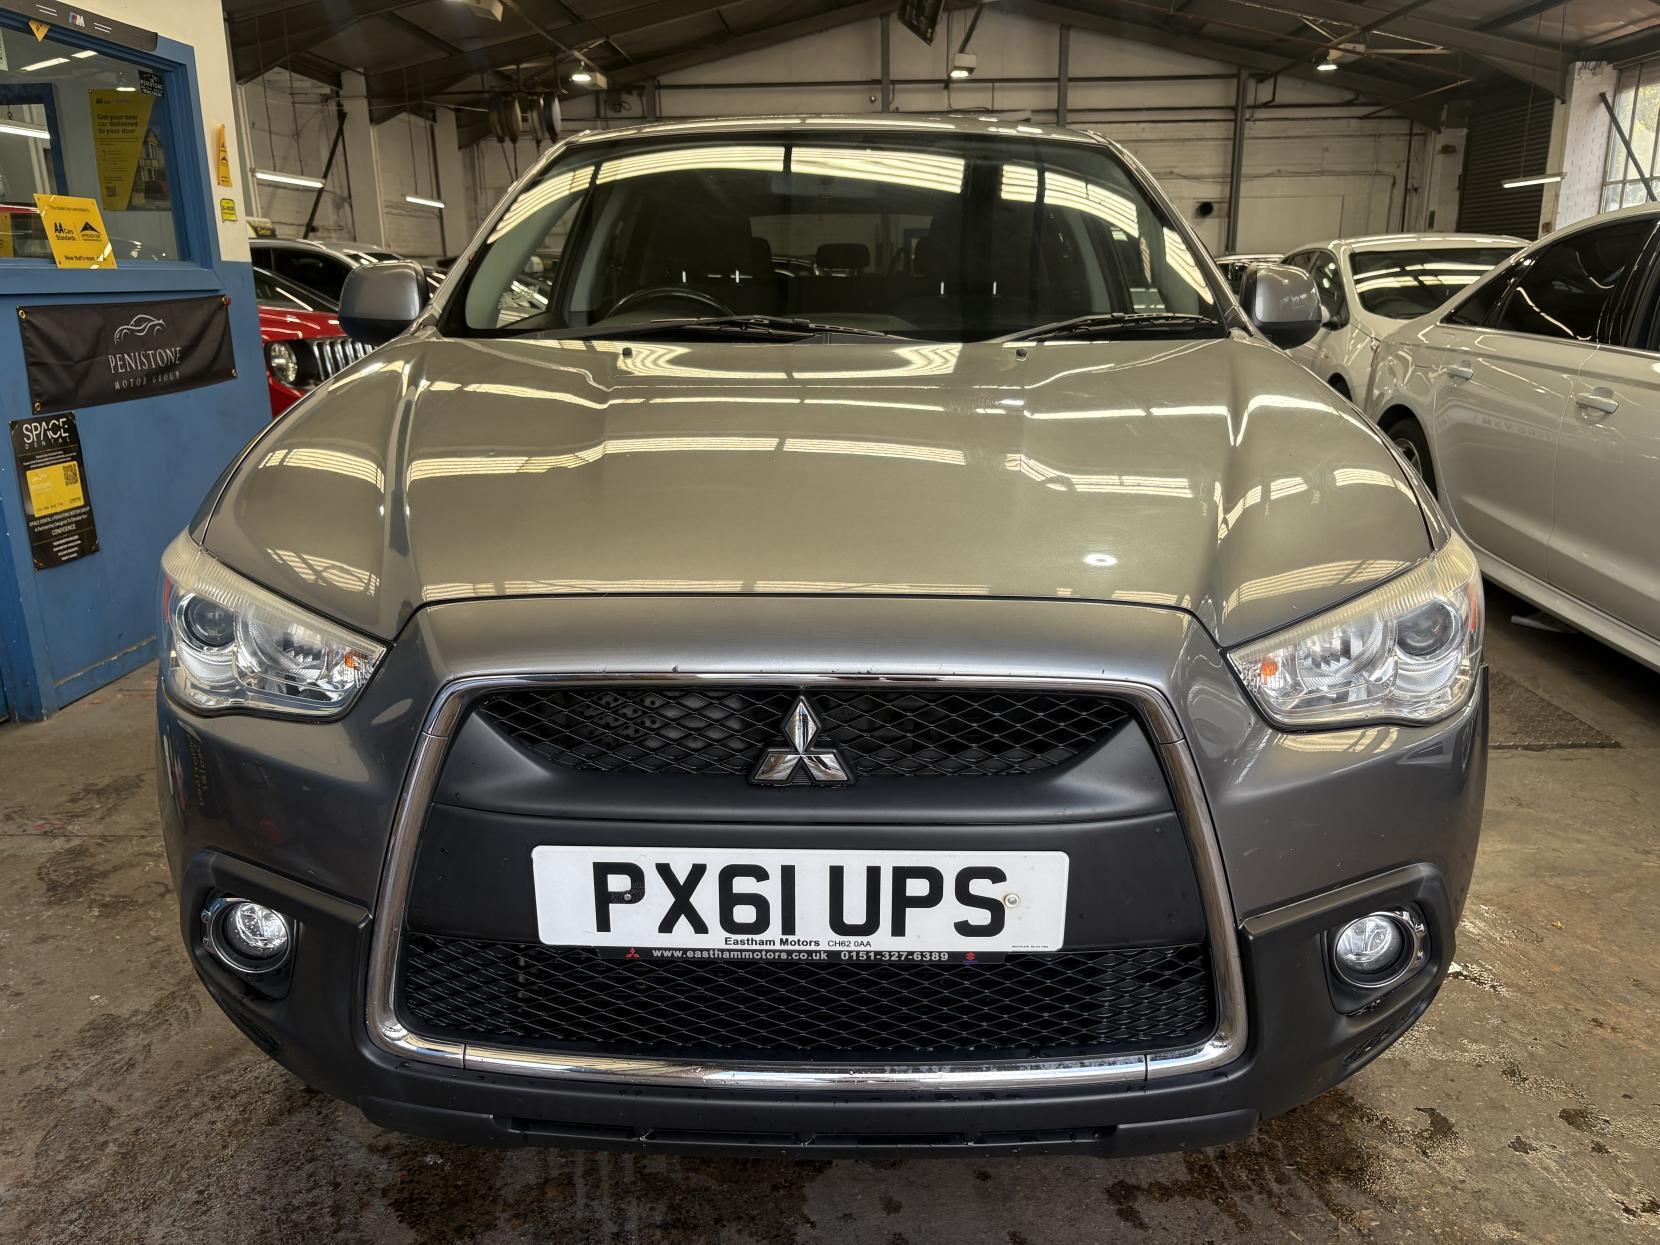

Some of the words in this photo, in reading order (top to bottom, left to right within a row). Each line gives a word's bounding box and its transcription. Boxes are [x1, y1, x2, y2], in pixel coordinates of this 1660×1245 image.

[54, 222, 64, 234] AA
[108, 347, 182, 374] PENISTONE
[114, 378, 147, 390] MOTOR
[152, 370, 180, 384] GROUP
[22, 418, 69, 444] SPACE
[24, 437, 70, 450] DENTAL
[51, 524, 76, 535] CONFIDENCE
[593, 862, 796, 936] PX61
[829, 866, 1007, 938] UPS
[724, 936, 776, 947] Eastham
[779, 938, 820, 947] Motors
[827, 940, 851, 948] CH62
[853, 940, 872, 948] 0AA
[652, 948, 828, 960] www.easthammotors.co.uk
[840, 951, 949, 961] 0151-327-6389
